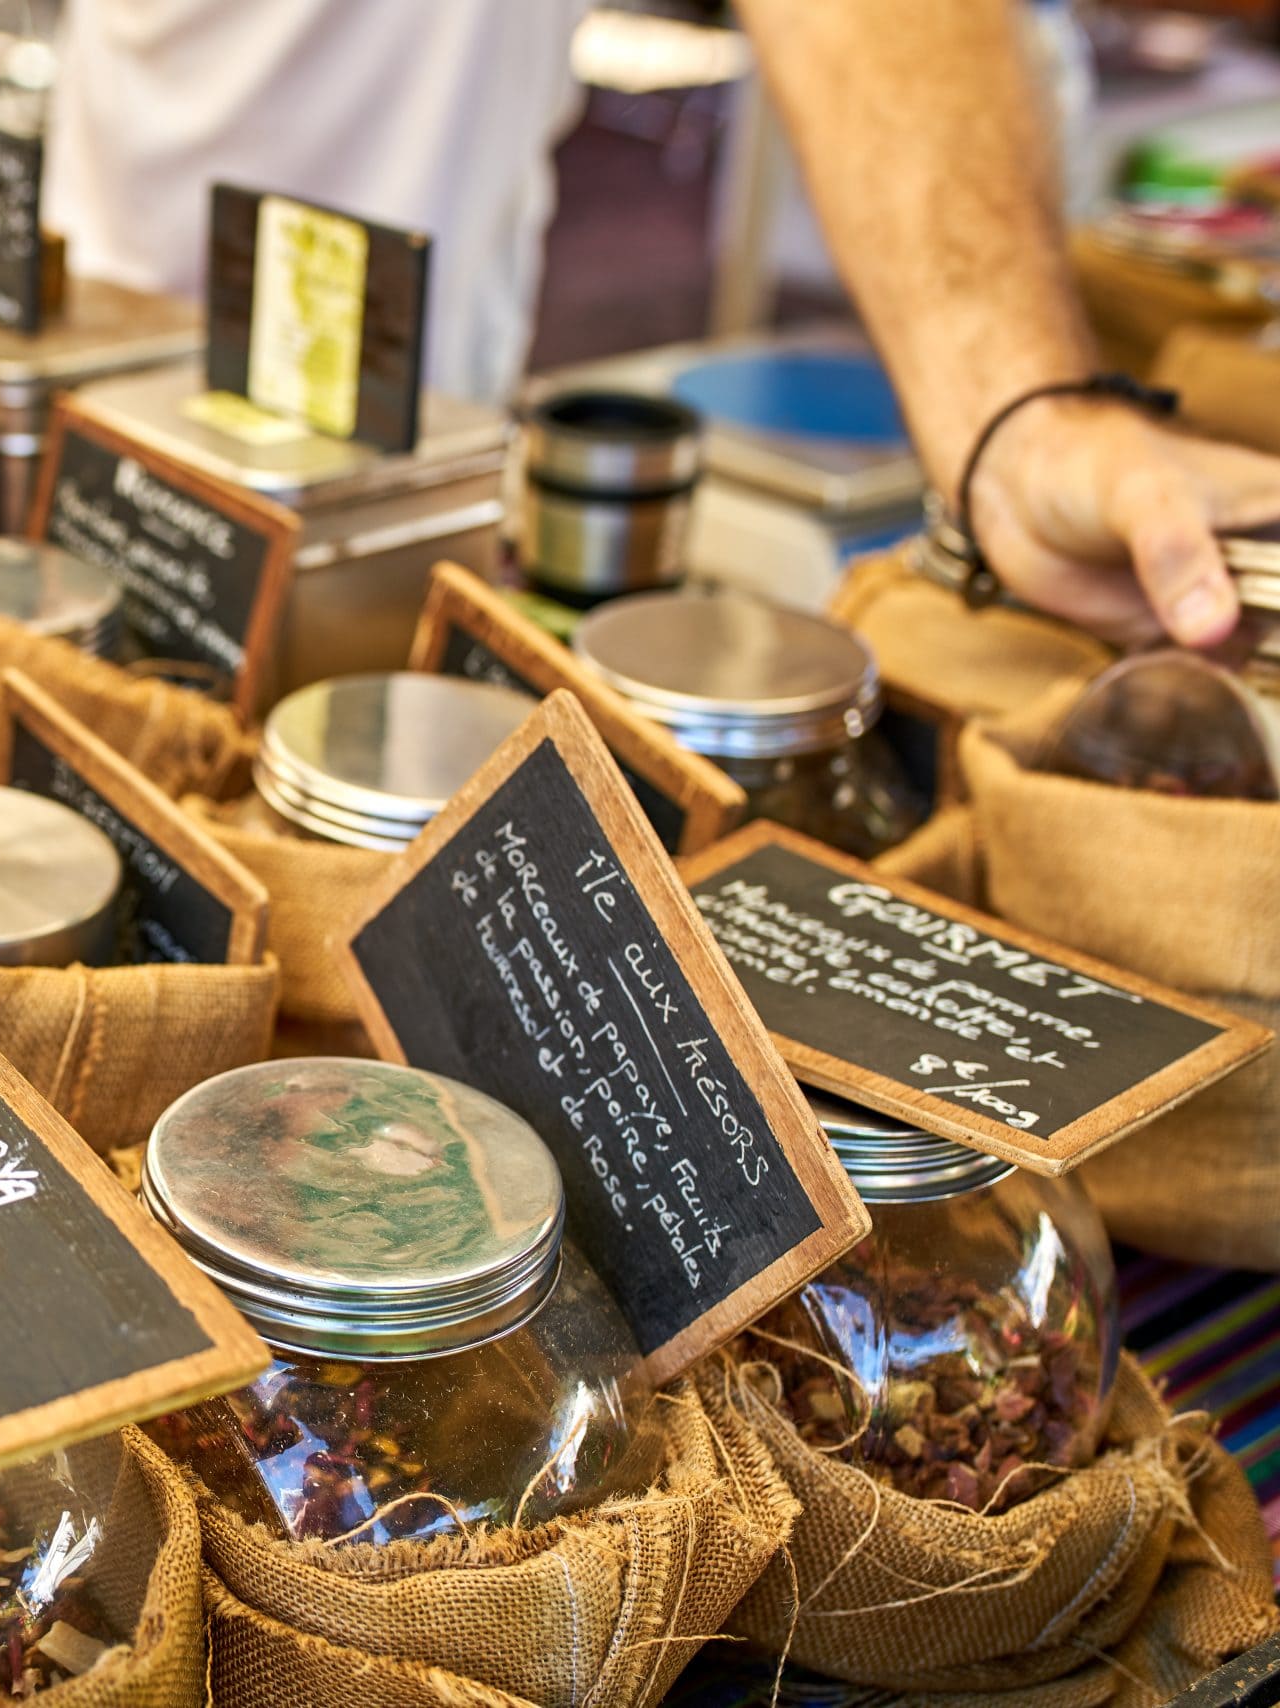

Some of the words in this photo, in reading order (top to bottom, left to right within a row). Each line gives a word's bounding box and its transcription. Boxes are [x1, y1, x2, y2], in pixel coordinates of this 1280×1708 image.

[624, 943, 679, 1024] aux
[827, 882, 1144, 1003] GOURMET
[451, 869, 479, 907] de
[538, 1047, 565, 1078] et
[560, 1095, 586, 1131] de
[827, 976, 983, 1041] amande
[891, 956, 938, 980] de
[927, 978, 1101, 1048] pomme,
[475, 849, 499, 884] de
[496, 886, 516, 932] la
[507, 937, 591, 1075] passion,
[642, 1193, 704, 1290] pétales
[577, 981, 604, 1017] de
[591, 1021, 673, 1152] papaye,
[1004, 1044, 1067, 1069] et
